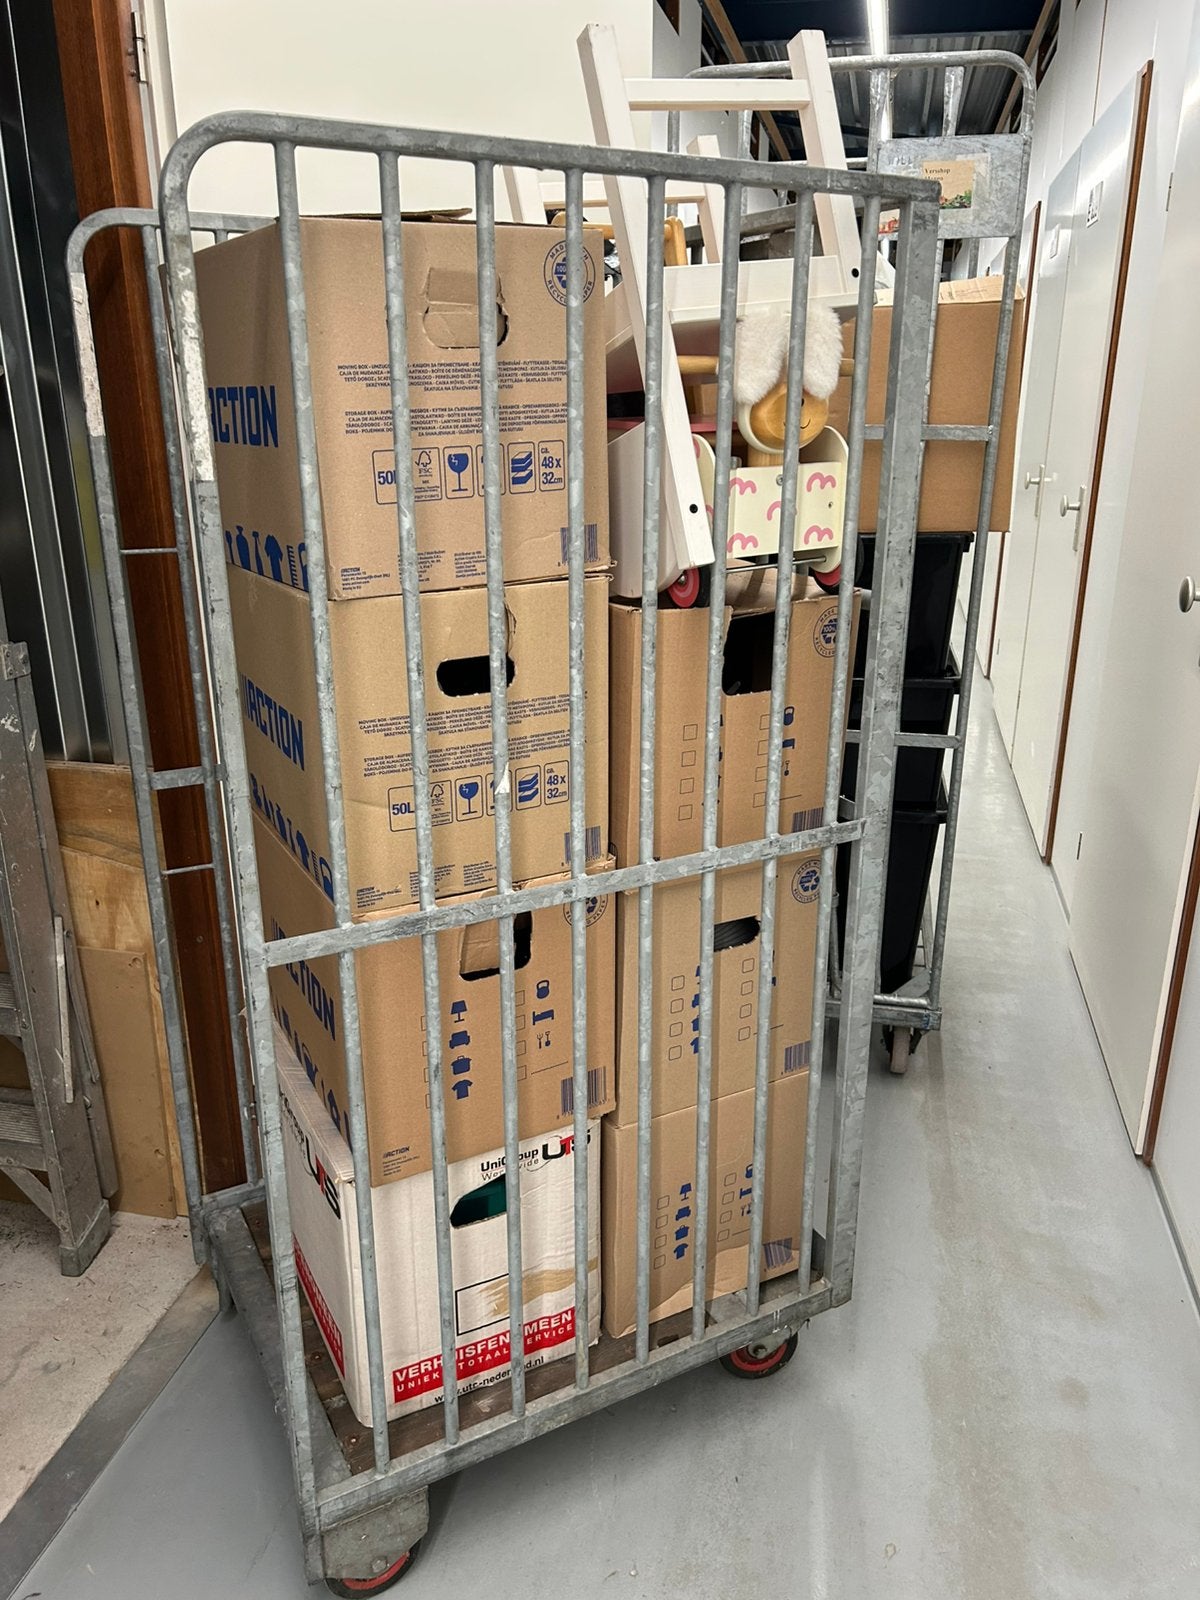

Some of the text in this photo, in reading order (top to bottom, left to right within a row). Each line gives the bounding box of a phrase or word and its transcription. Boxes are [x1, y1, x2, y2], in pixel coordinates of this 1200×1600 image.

[542, 456, 554, 468] 48
[542, 472, 562, 484] 32cm
[246, 678, 305, 772] ACTION
[546, 775, 559, 786] 48
[392, 802, 415, 815] 50L
[481, 1148, 538, 1172] UniGoup
[481, 1158, 539, 1181] Woride
[395, 1310, 572, 1382] VERHISFENMEEN
[397, 1371, 440, 1392] UNIEK
[527, 1323, 572, 1345] ERVICE
